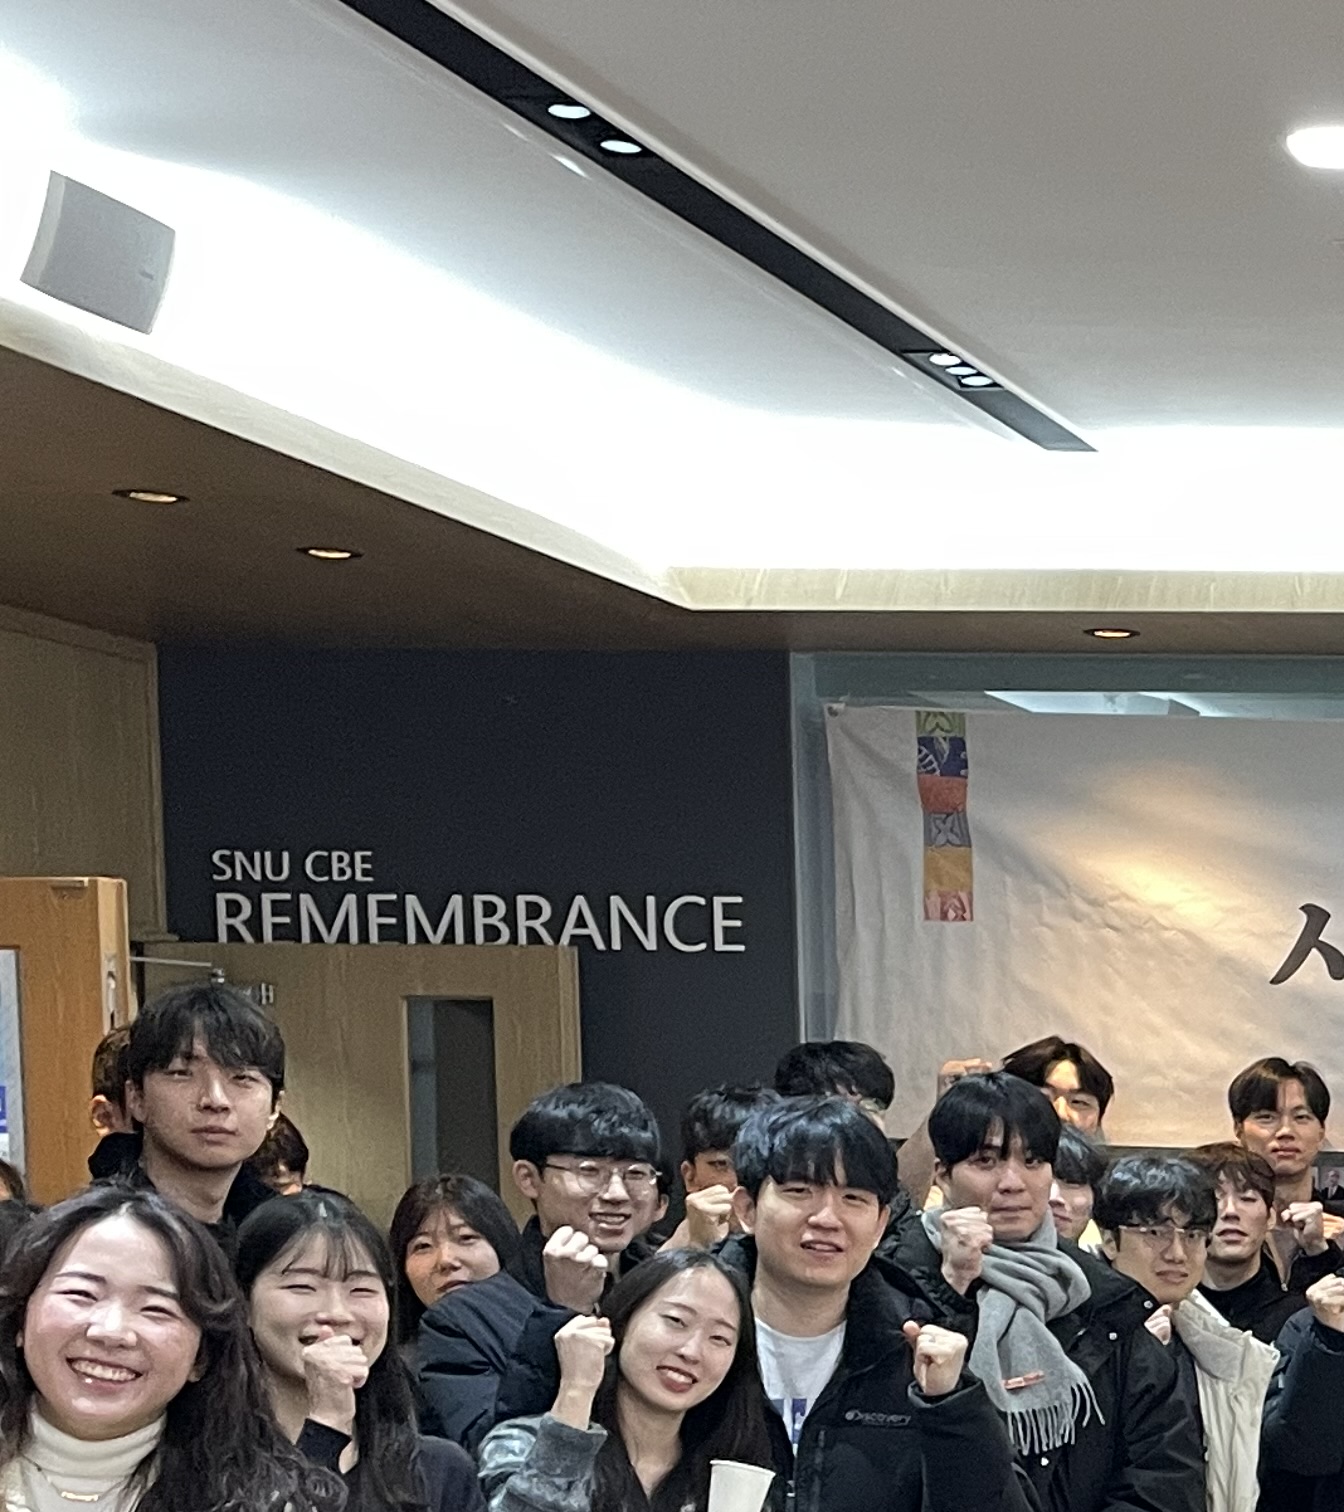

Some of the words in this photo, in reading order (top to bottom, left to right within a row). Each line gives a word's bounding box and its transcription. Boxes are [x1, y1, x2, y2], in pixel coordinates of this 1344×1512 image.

[211, 849, 291, 882] SNU
[304, 849, 375, 882] CBE
[215, 892, 746, 953] REMEMBRANCE
